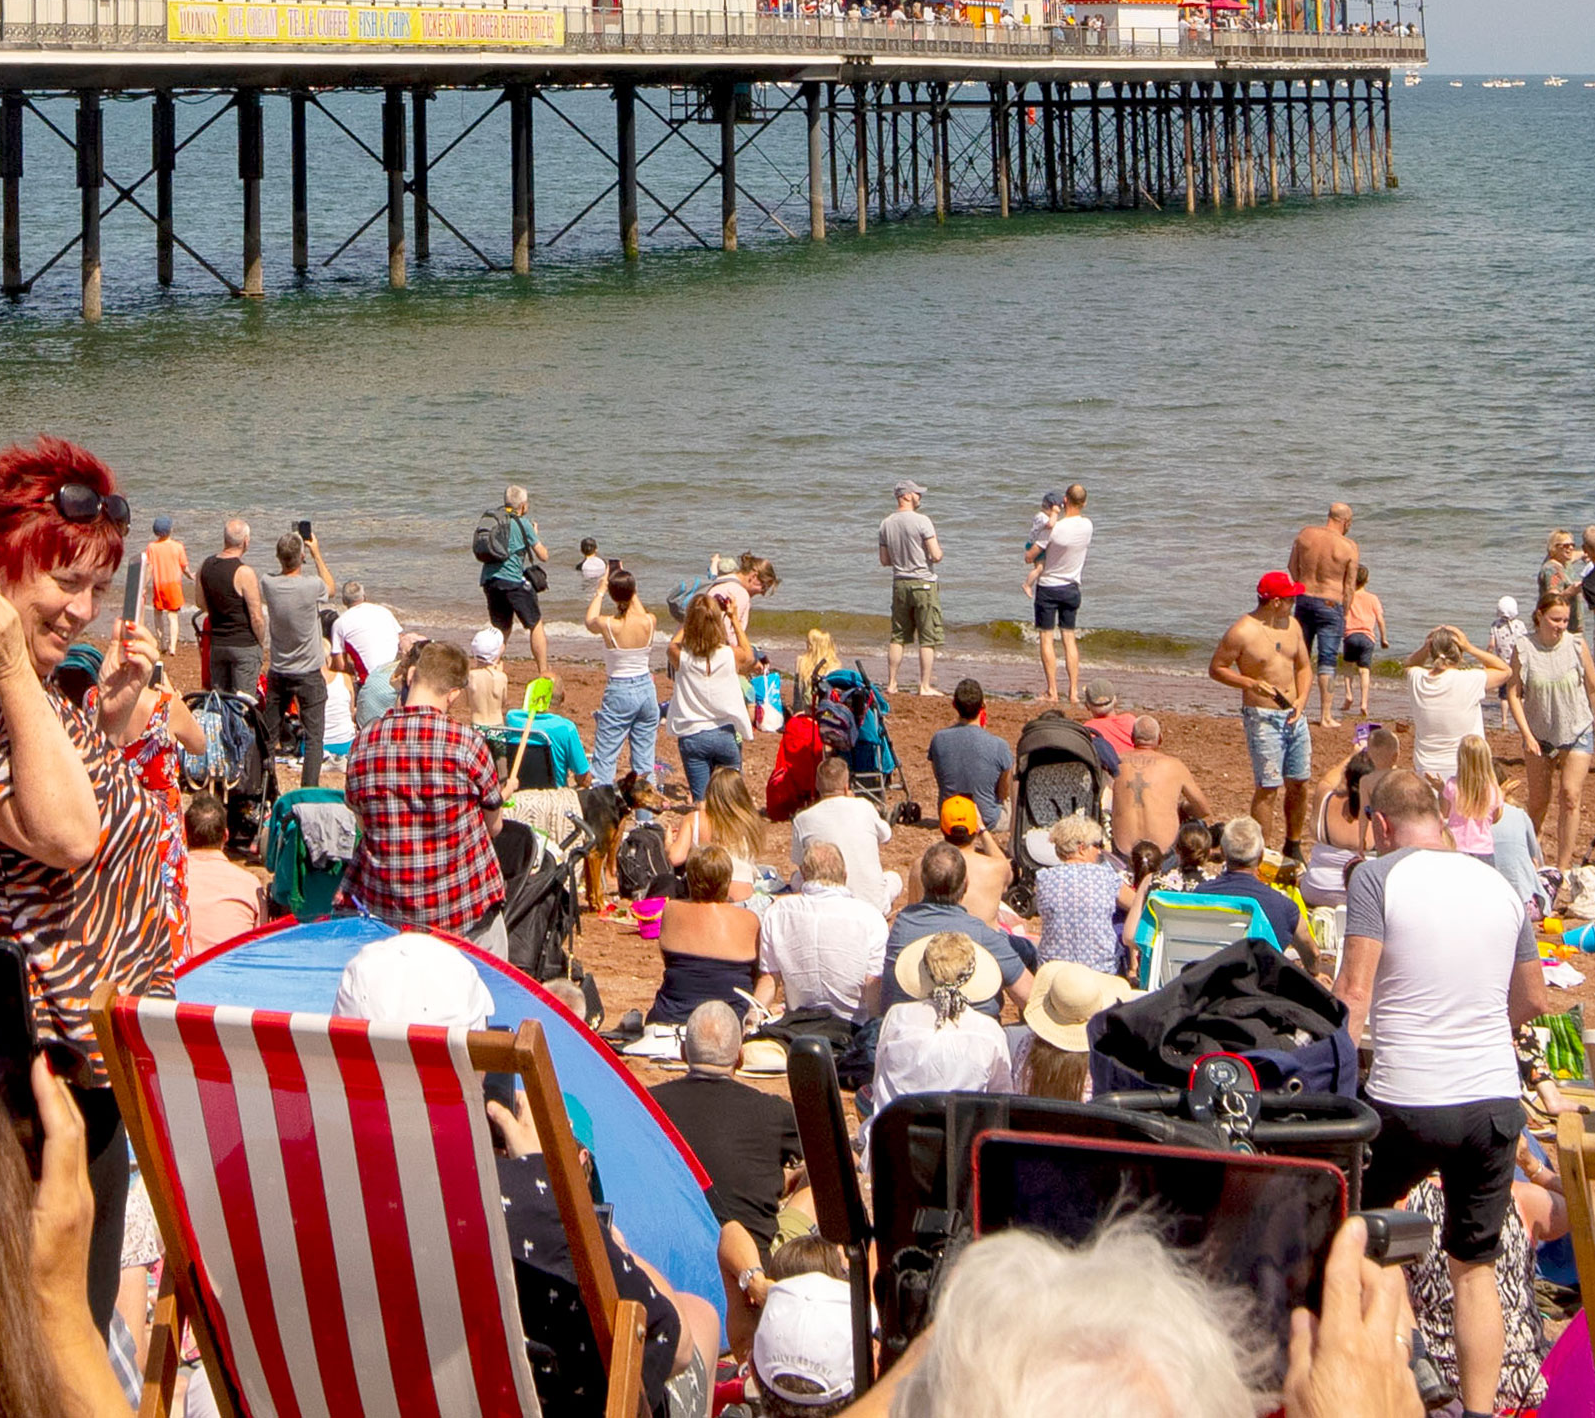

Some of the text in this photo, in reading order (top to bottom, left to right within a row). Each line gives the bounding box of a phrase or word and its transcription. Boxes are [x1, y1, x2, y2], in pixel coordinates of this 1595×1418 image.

[228, 8, 244, 36] ICE
[247, 8, 278, 36] CREAM
[288, 9, 306, 36] TEA
[317, 10, 349, 37] COFFEE
[358, 11, 377, 37] FISH
[387, 12, 410, 38] CHIPS
[421, 13, 452, 38] TICKETS
[455, 13, 470, 38] WIN
[472, 14, 499, 38] BIGGER
[501, 15, 529, 39] BETTER
[530, 15, 554, 39] PRIZES
